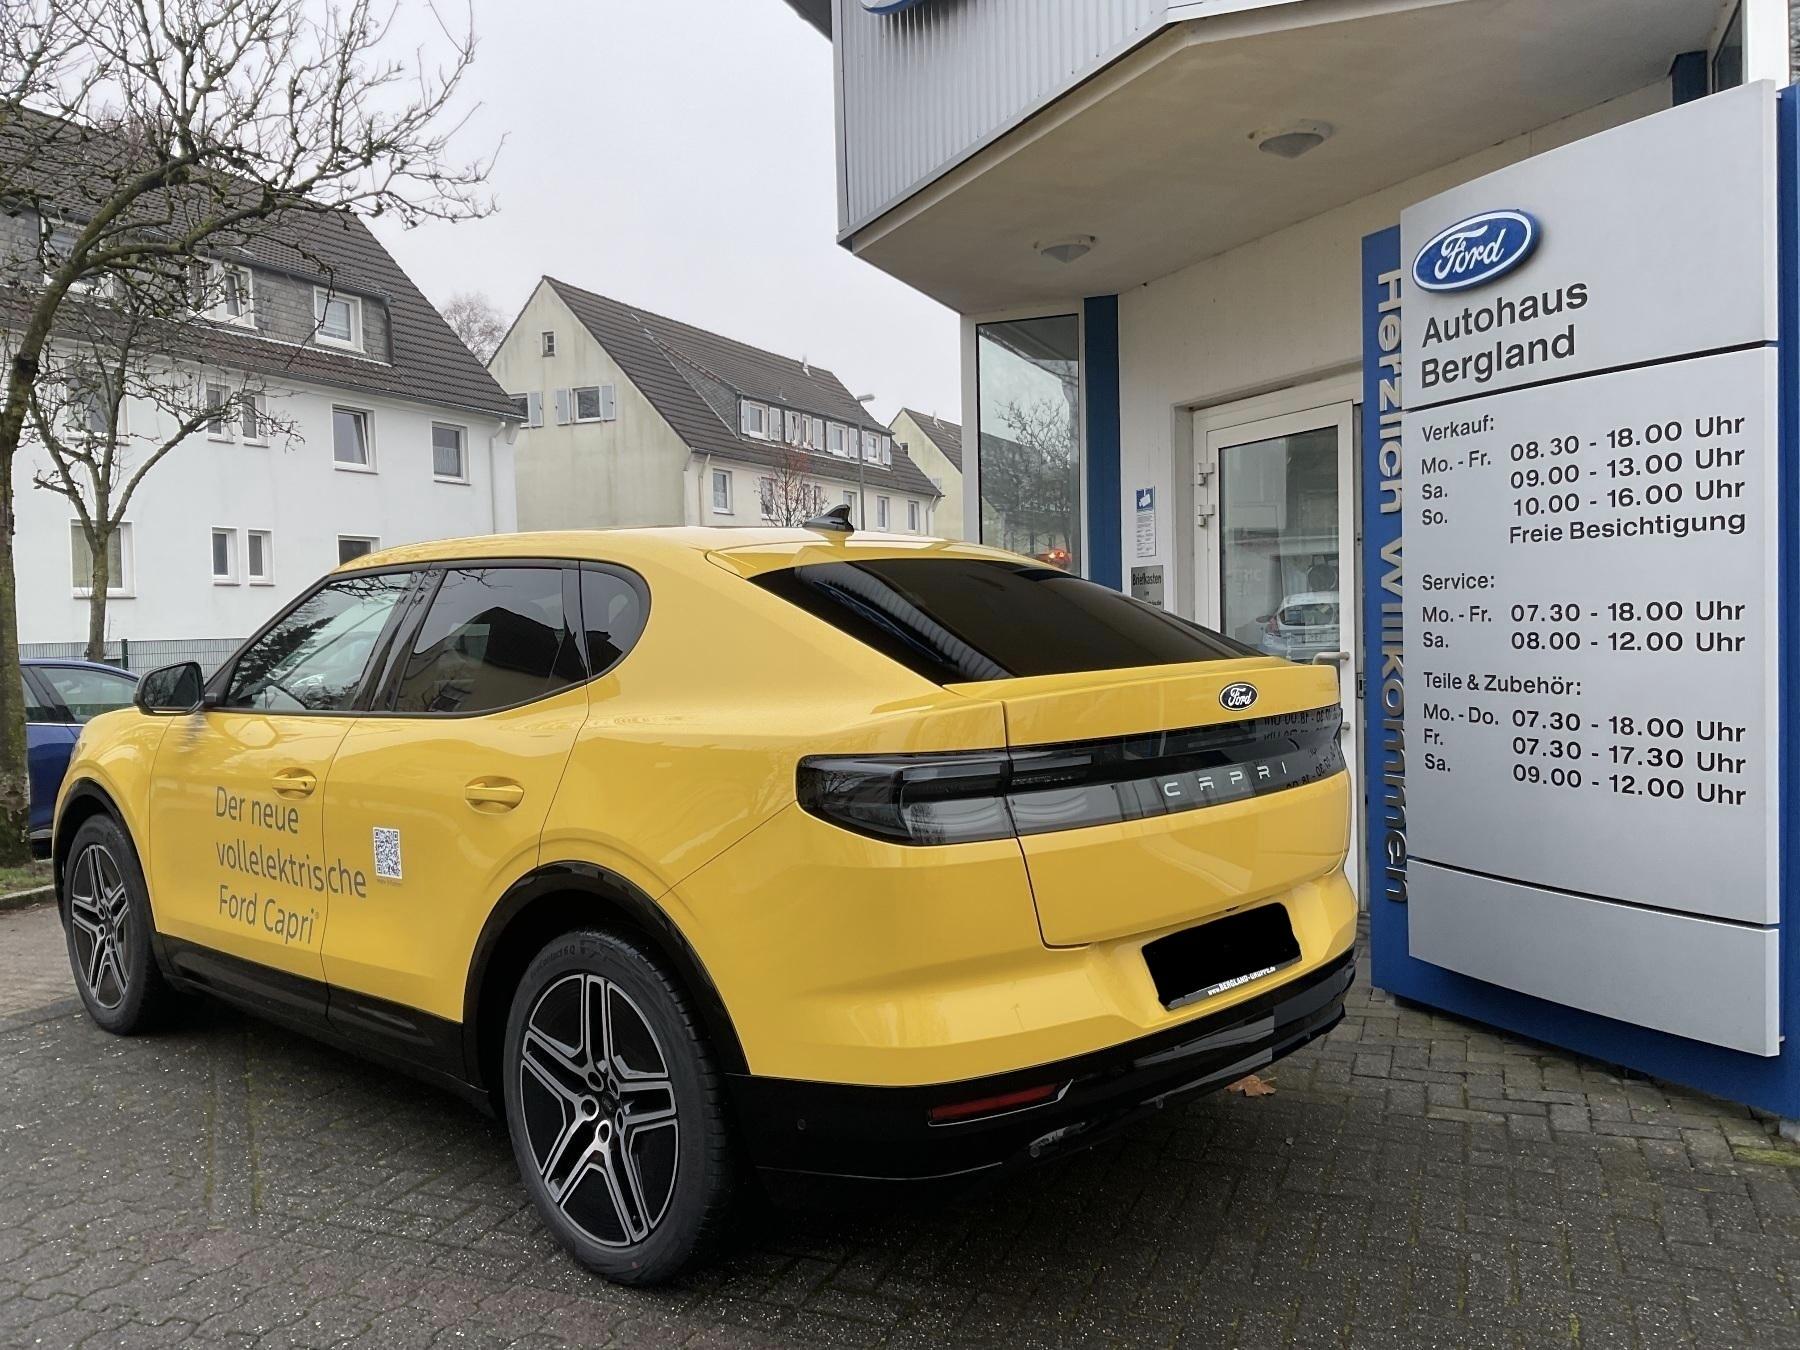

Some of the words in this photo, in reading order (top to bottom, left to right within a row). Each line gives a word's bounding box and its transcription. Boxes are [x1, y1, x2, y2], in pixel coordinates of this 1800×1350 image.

[1434, 224, 1506, 279] Ford
[1422, 283, 1588, 348] Autohaus
[1422, 324, 1575, 389] Bergland
[1378, 269, 1402, 513] Herzlich
[1422, 415, 1494, 442] Verkauf:
[1510, 436, 1580, 462] 08.30
[1606, 422, 1683, 449] 18.00
[1695, 416, 1746, 438] Uhr
[1422, 484, 1448, 501] Sa.
[1510, 464, 1580, 490] 09.00
[1606, 452, 1683, 479] 13.00
[1695, 448, 1746, 470] Uhr
[1421, 509, 1448, 526] So.
[1513, 493, 1580, 517] 10.00
[1606, 483, 1683, 508] 16.00
[1695, 479, 1746, 501] Uhr
[1509, 524, 1563, 544] Freie
[1569, 513, 1746, 540] Besichtigung
[1132, 572, 1162, 586] Briefkasten
[1422, 573, 1495, 591] Service:
[1510, 604, 1581, 623] 07.30
[1607, 601, 1683, 622] 18.00
[1695, 601, 1746, 621] Uhr
[1423, 632, 1449, 649] Sa.
[1511, 631, 1581, 650] 08.00
[1607, 631, 1684, 652] 12.00
[1695, 631, 1746, 652] Uhr
[1228, 687, 1251, 707] Ford
[1423, 672, 1463, 690] Teile
[1466, 673, 1480, 691] &
[1483, 675, 1582, 696] Zubehör:
[1512, 710, 1581, 732] 07.30
[1608, 716, 1684, 739] 18.00
[1696, 721, 1746, 743] Uhr
[1423, 728, 1444, 746] Fr.
[1512, 737, 1582, 760] 07.30
[1608, 745, 1684, 769] 17.30
[1696, 752, 1747, 774] Uhr
[1163, 761, 1287, 797] CAPRI
[1424, 753, 1451, 773] Sa.
[1512, 764, 1582, 789] 09.00
[1608, 774, 1685, 800] 12.00
[1697, 782, 1747, 806] Uhr
[215, 786, 245, 822] Der
[251, 799, 299, 834] neue
[216, 838, 367, 898] vollelektrische
[219, 884, 257, 927] Ford
[263, 898, 315, 944] Capri
